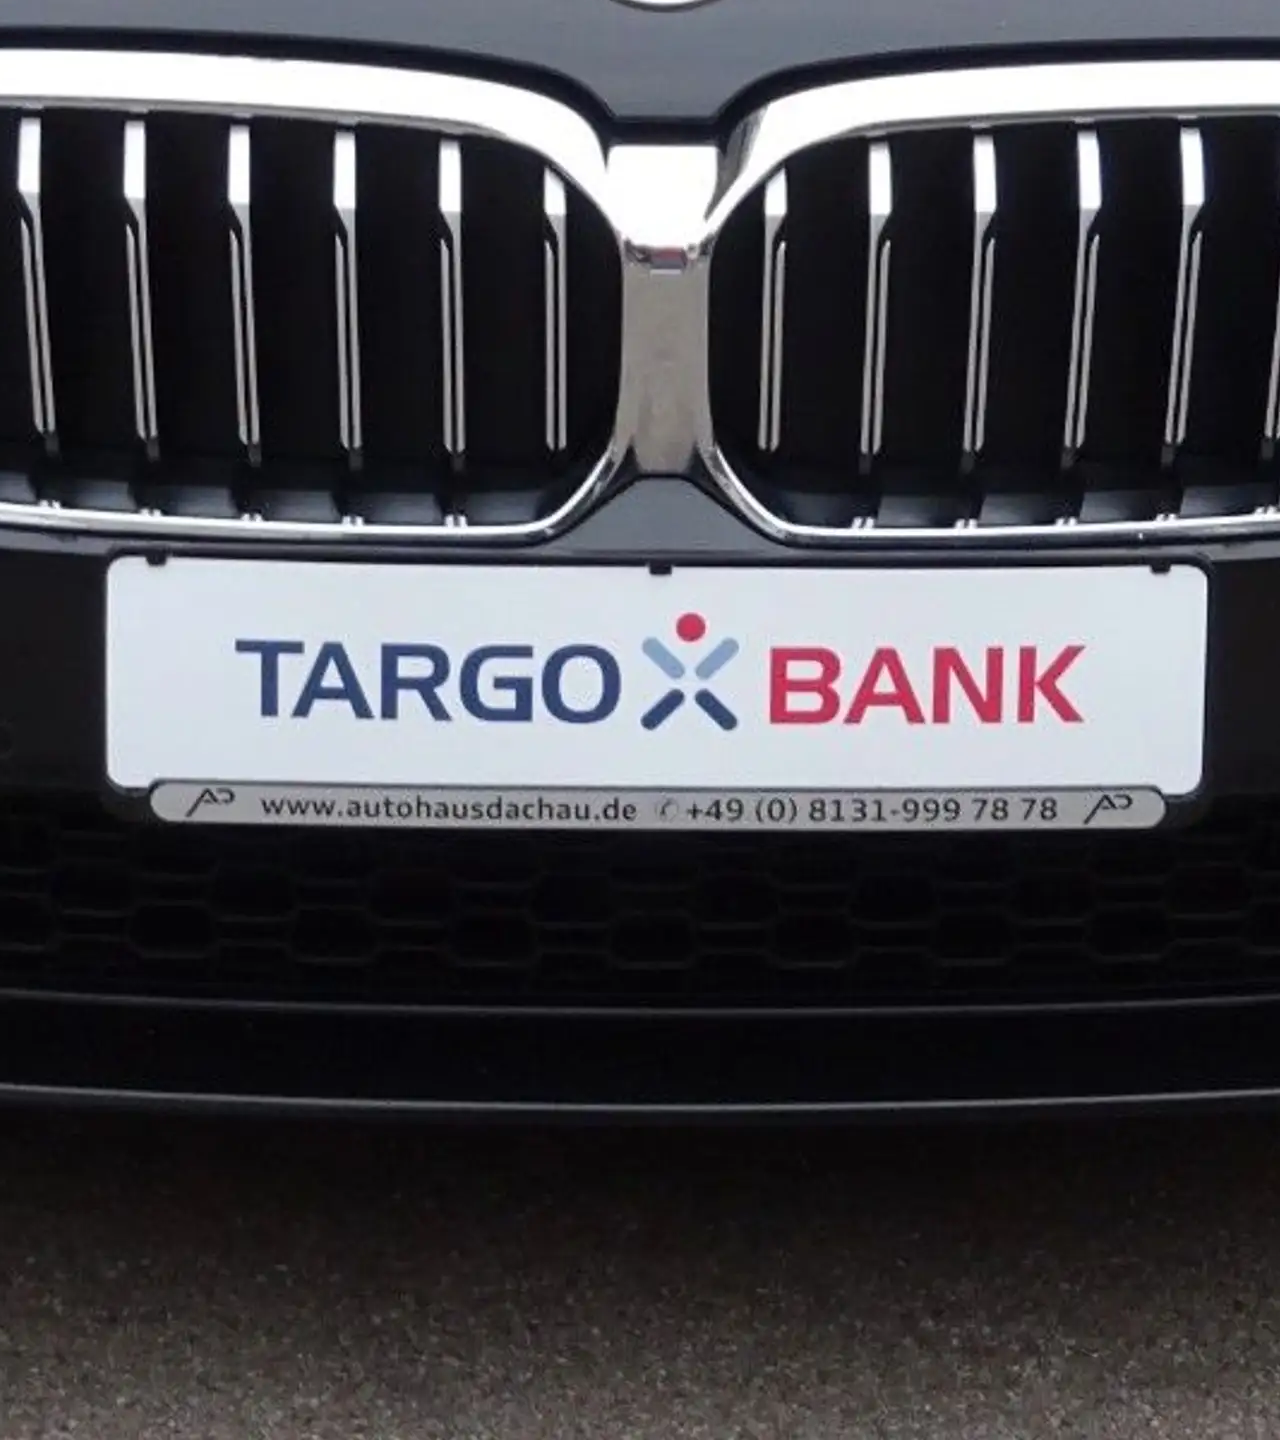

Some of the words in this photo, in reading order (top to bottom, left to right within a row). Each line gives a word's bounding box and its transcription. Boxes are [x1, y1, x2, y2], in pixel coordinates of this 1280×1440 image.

[235, 639, 621, 725] TARGO
[768, 644, 1086, 725] BANK
[261, 794, 638, 823] www.autohausdachau.de
[686, 797, 744, 823] +49
[754, 796, 797, 826] (0)
[808, 797, 961, 823] 8131-999
[973, 798, 1008, 823] 78
[1022, 798, 1058, 823] 78
